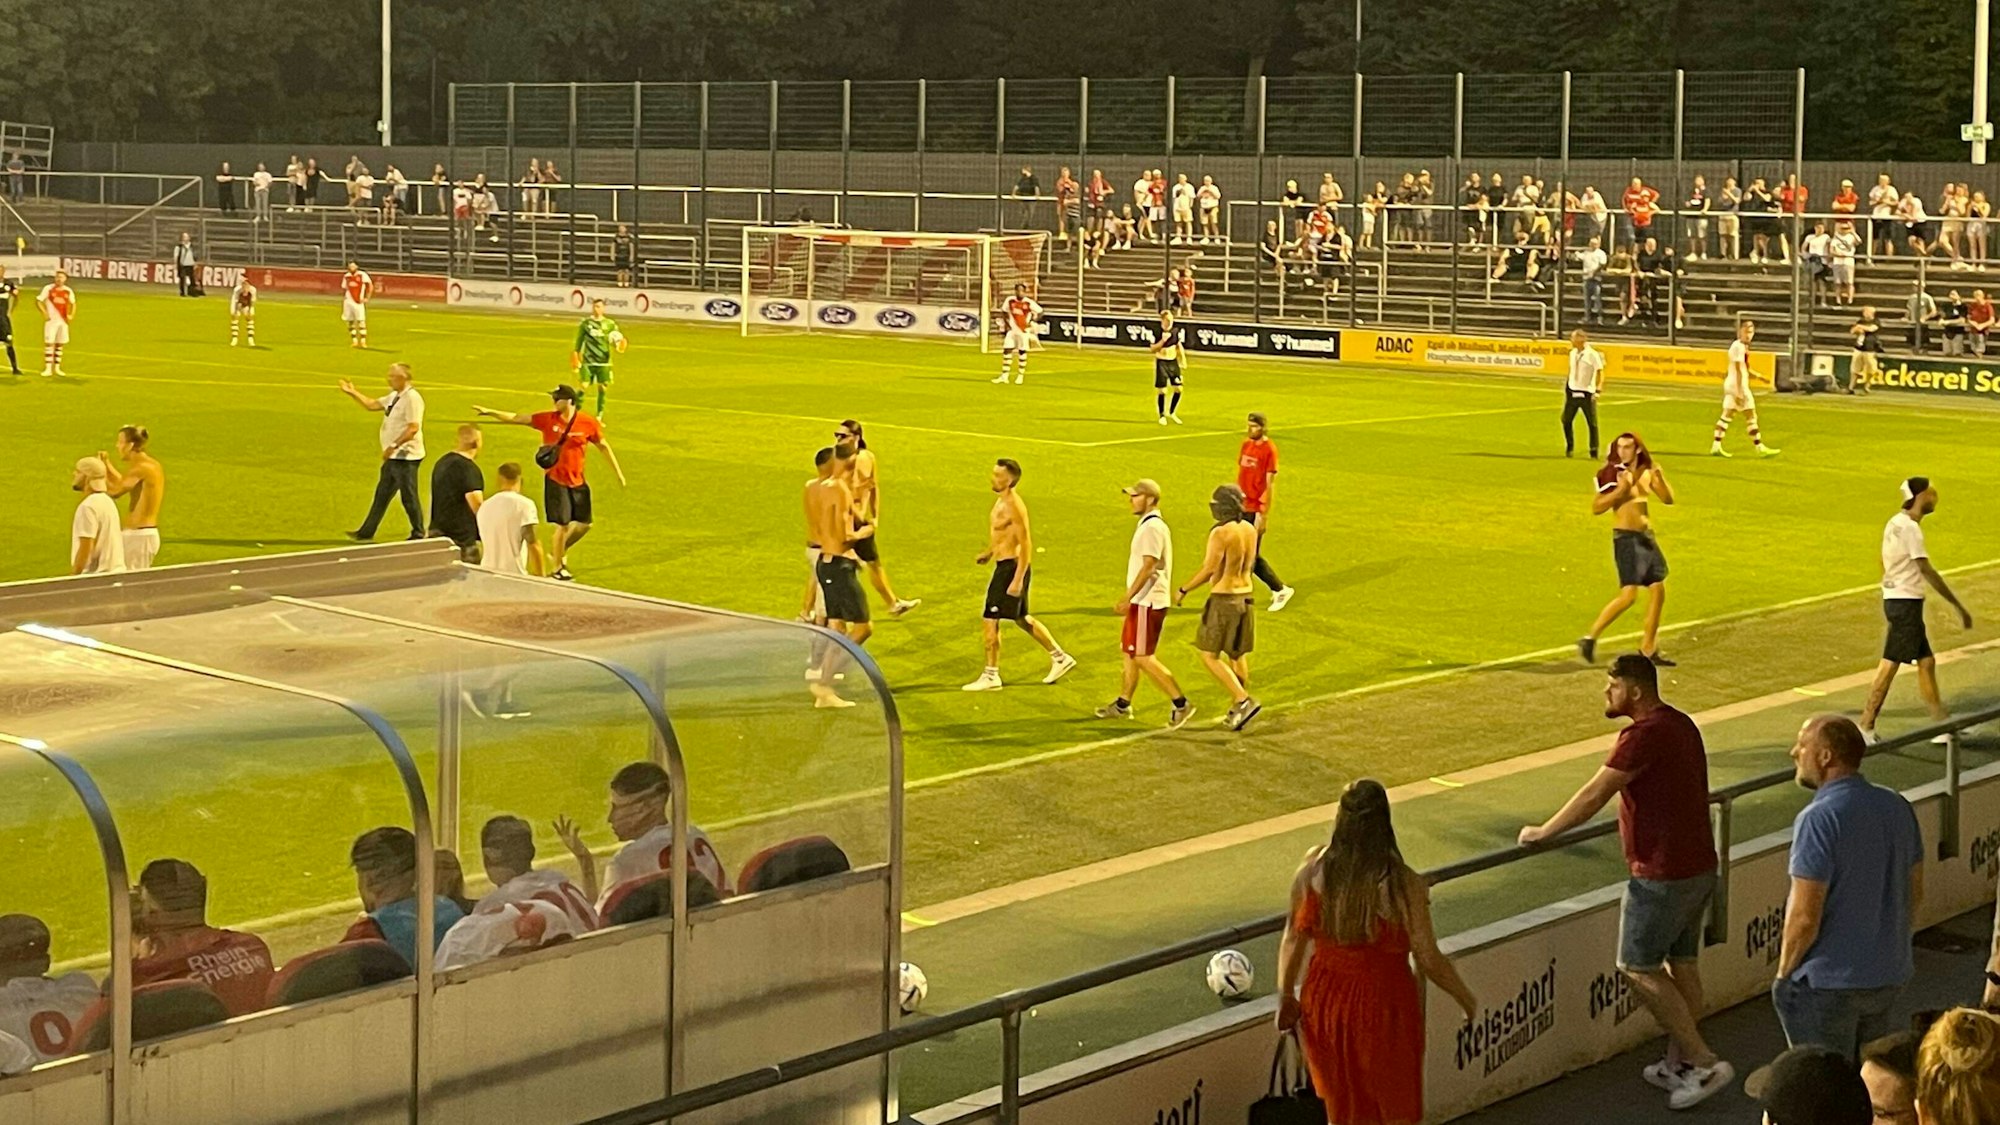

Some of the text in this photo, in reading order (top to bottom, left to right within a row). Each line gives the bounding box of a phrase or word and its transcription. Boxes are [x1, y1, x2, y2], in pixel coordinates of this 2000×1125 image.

[63, 258, 103, 279] REWE
[107, 260, 148, 282] REWE
[202, 266, 248, 288] REWE
[709, 299, 737, 316] Ford
[765, 303, 793, 320] Ford
[823, 306, 851, 323] Ford
[882, 310, 910, 327] Ford
[943, 313, 973, 331] Ford
[1211, 330, 1258, 347] hummel
[1286, 334, 1334, 352] hummel
[1375, 336, 1414, 353] ADAC
[1427, 352, 1476, 364] Hauptsache
[1478, 355, 1492, 364] mit
[1493, 356, 1513, 365] dem
[1856, 362, 1969, 391] äckerei
[187, 946, 250, 973] Rhein
[1456, 957, 1556, 1070] Reissdorf
[1484, 1003, 1554, 1078] ALKOHOLFREI
